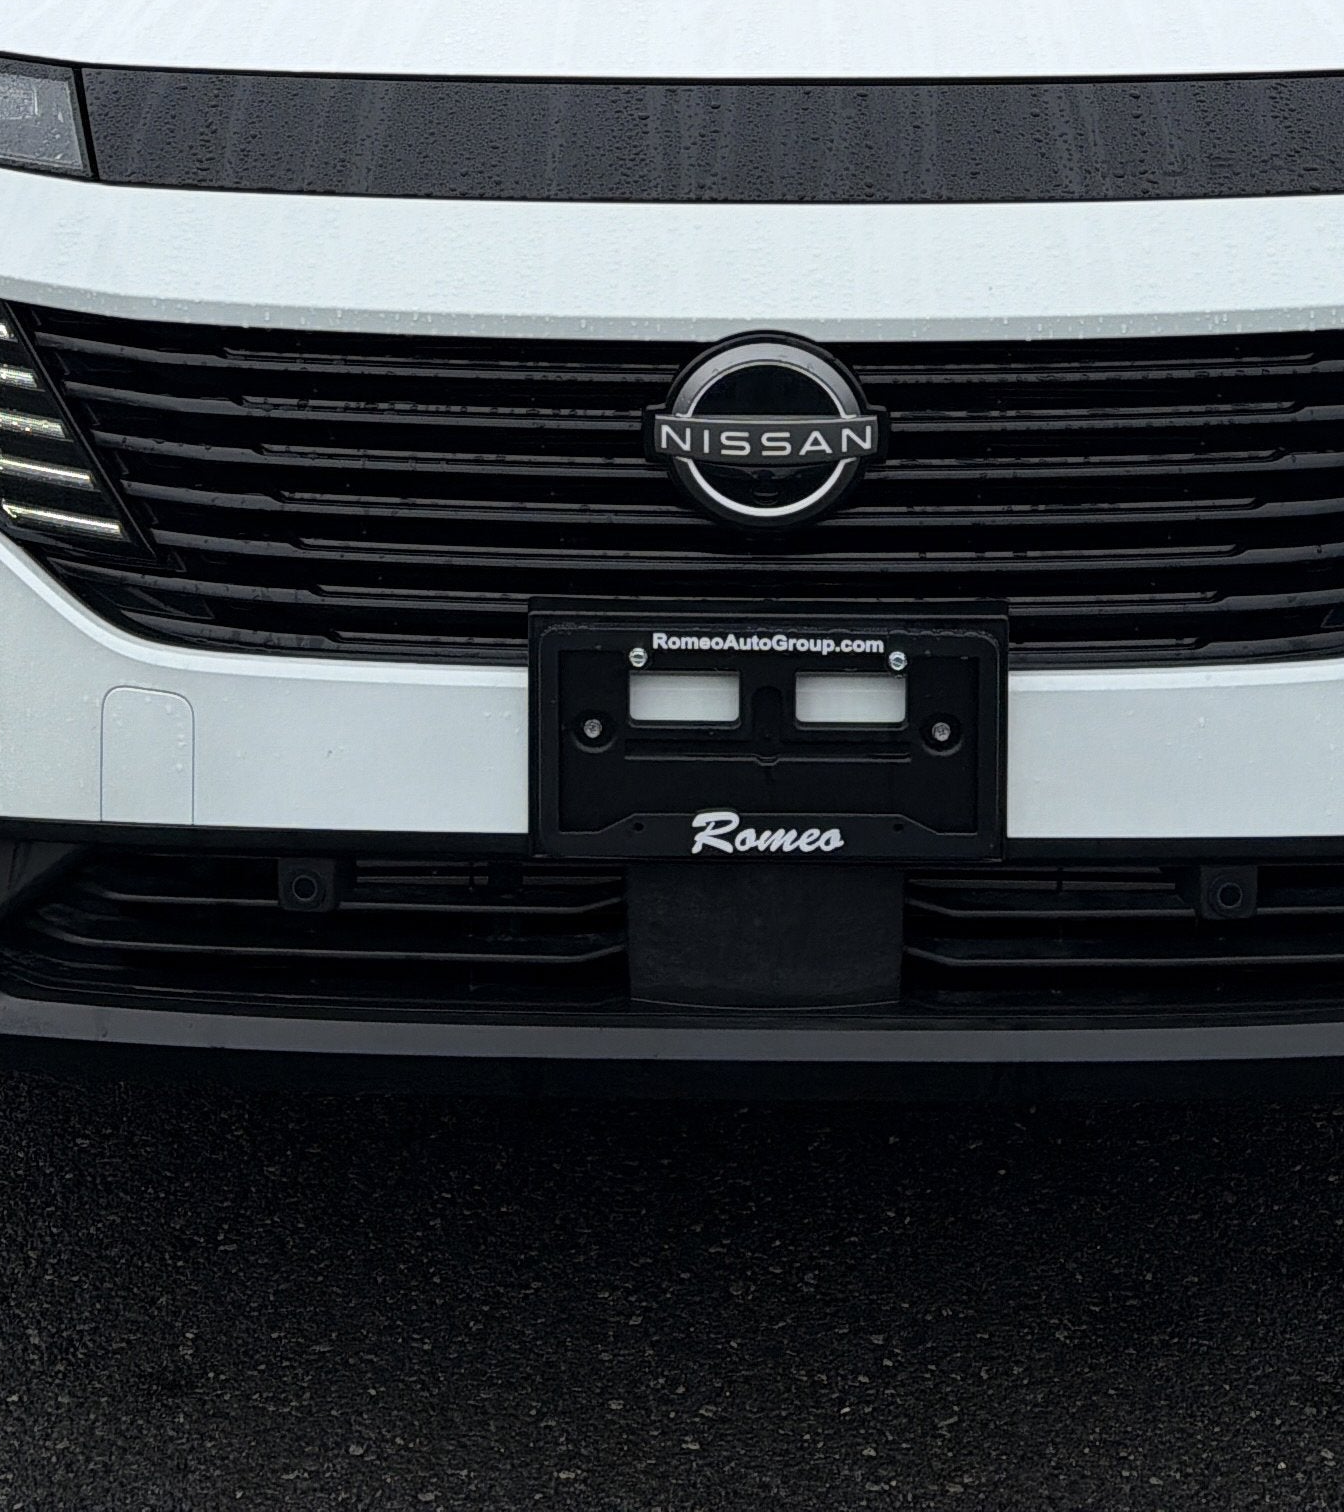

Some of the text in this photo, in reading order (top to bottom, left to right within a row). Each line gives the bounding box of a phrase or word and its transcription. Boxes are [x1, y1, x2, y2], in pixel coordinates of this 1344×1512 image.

[660, 424, 872, 456] NISSAN
[652, 633, 884, 655] RomeoAutoGroup.com
[691, 811, 844, 854] Romeo
